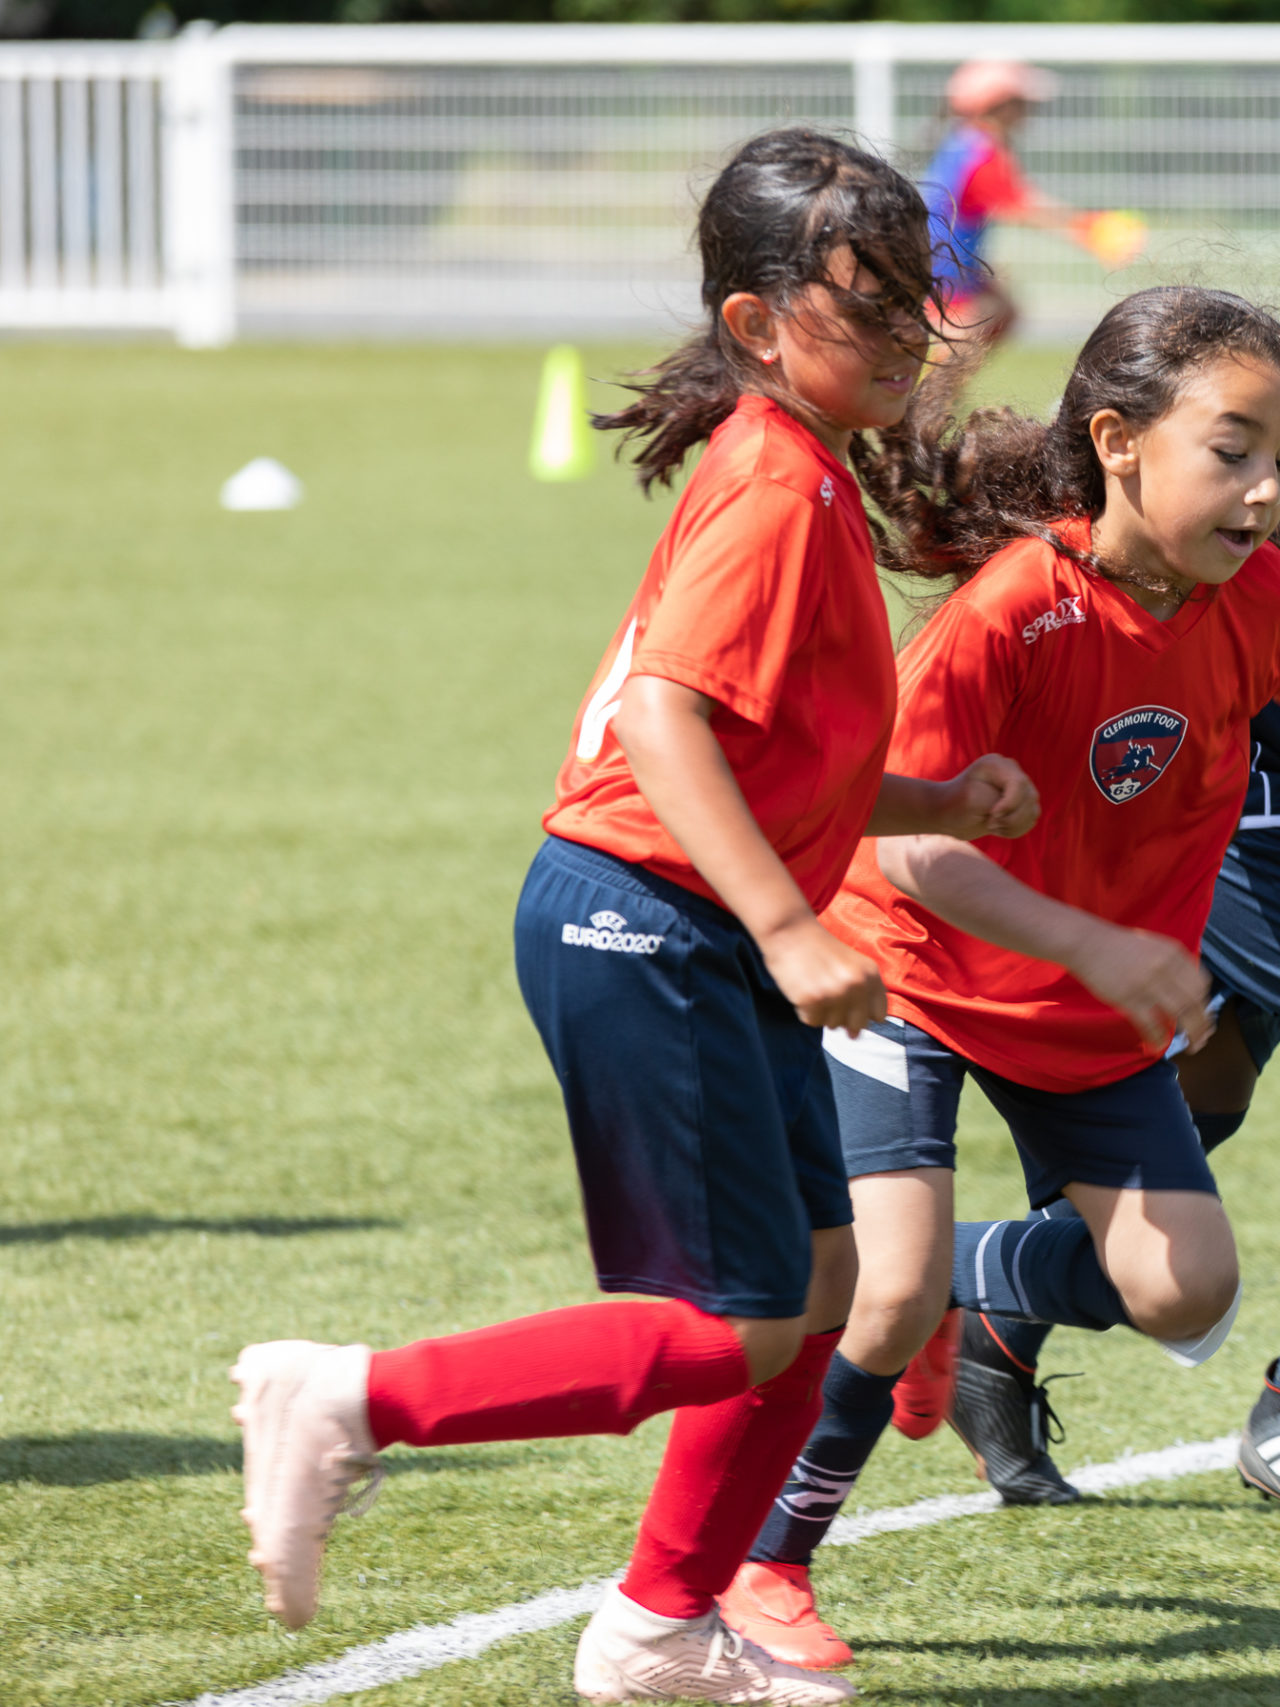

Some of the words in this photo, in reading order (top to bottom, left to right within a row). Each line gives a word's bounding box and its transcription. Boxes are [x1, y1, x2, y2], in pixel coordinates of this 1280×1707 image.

[1103, 712, 1153, 739] CLERMONT
[1153, 713, 1180, 731] FOOT
[1113, 784, 1135, 796] 63
[561, 923, 662, 955] EURO2020
